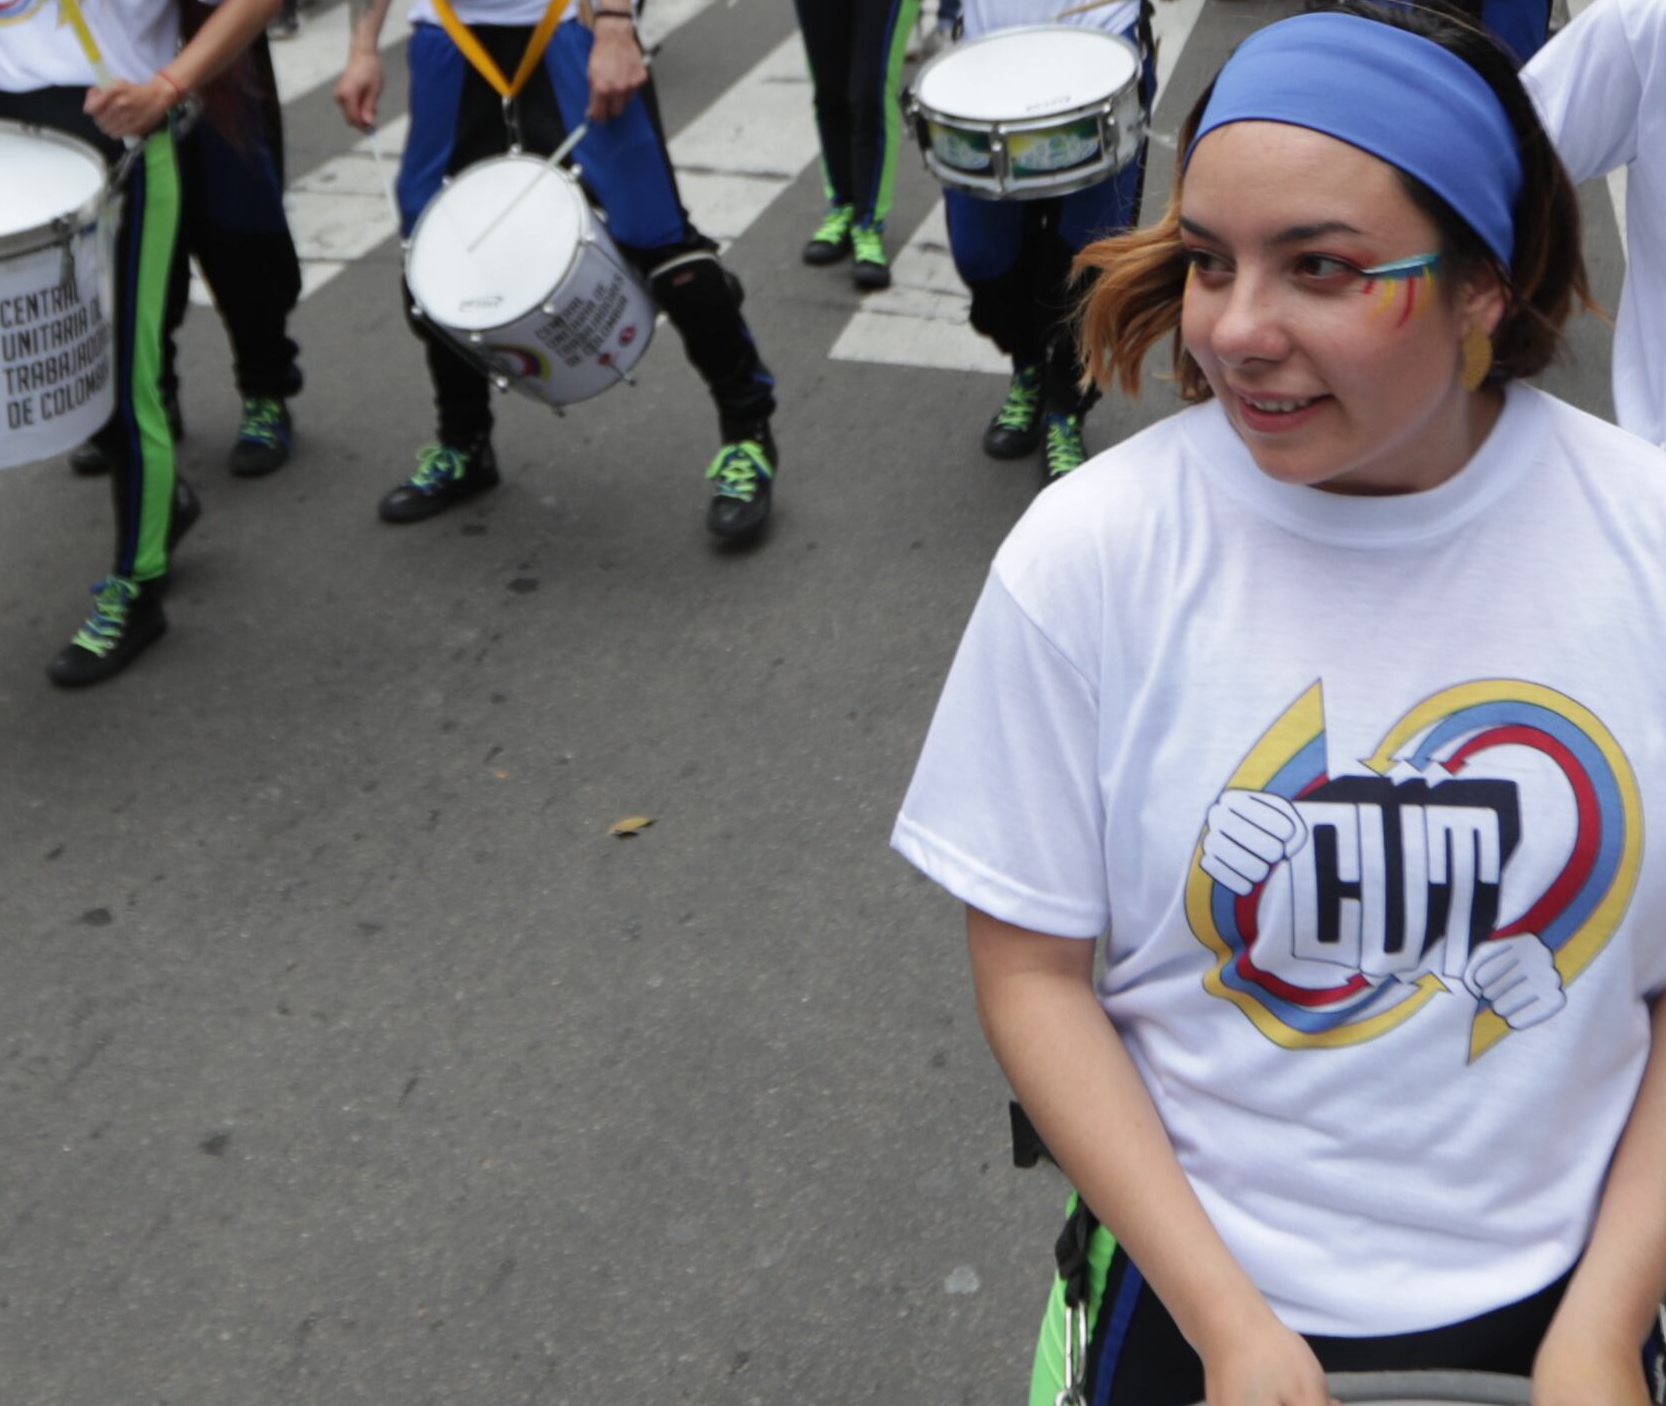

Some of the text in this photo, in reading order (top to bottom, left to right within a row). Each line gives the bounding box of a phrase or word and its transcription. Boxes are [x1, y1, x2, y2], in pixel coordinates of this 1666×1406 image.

[0, 281, 80, 329] CENTRAL
[2, 307, 88, 362] UNITARIA
[7, 398, 34, 430] DE
[1287, 775, 1522, 995] CUT
